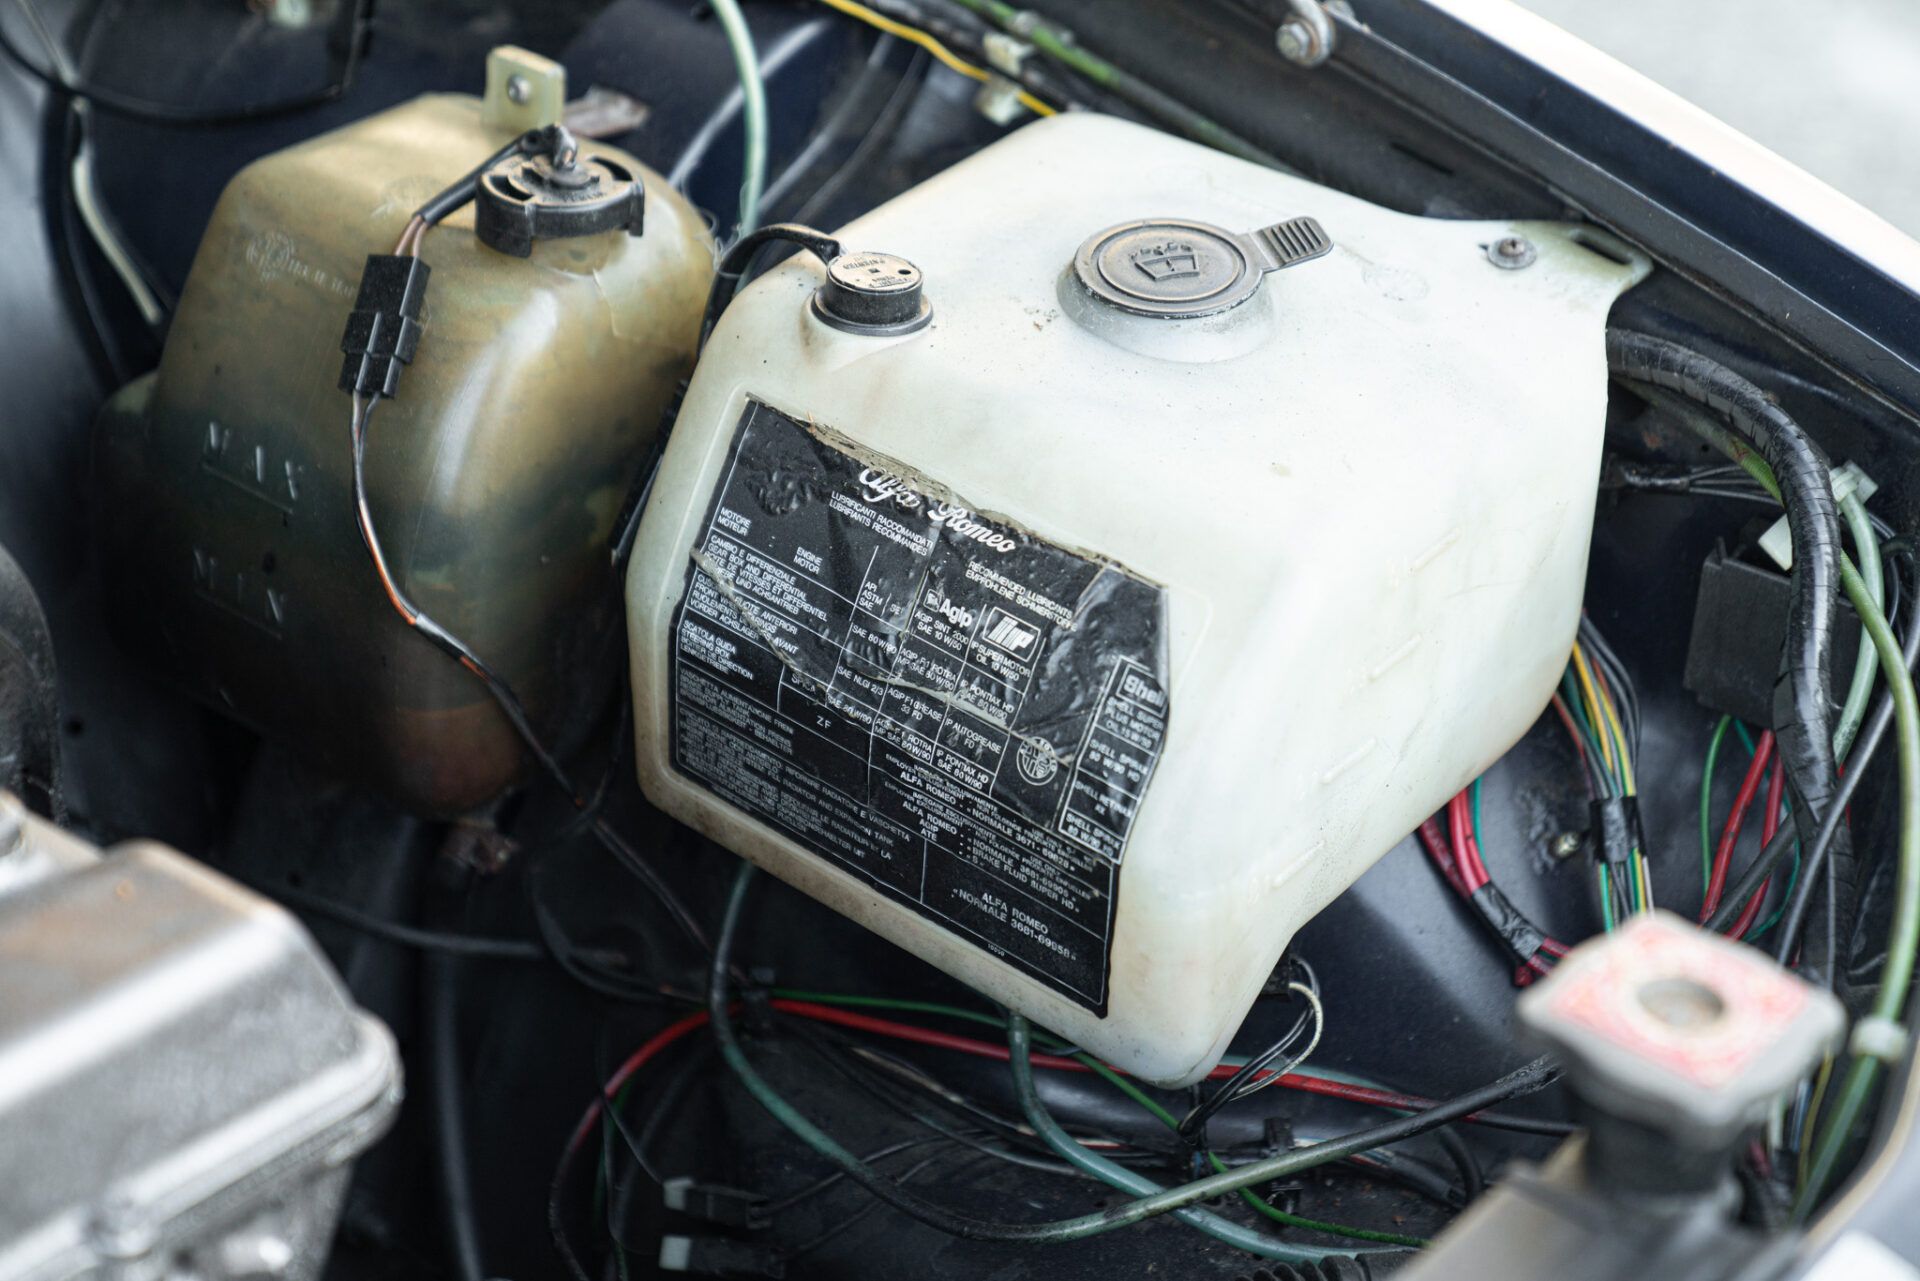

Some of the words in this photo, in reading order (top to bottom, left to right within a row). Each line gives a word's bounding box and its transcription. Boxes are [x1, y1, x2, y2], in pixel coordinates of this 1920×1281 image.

[720, 507, 750, 527] MOTORE
[831, 490, 876, 519] LUBRIFICANTI
[876, 514, 934, 549] RACCOMANDATI
[858, 467, 920, 511] Alfa
[927, 498, 1016, 552] Romeo
[717, 515, 747, 536] MOTEUR
[828, 499, 870, 526] LUBRIFIANTS
[871, 521, 927, 556] RECOMMANDES
[710, 534, 737, 554] CAMBIO
[738, 549, 745, 557] E
[745, 553, 796, 584] DIFFERENZIALE
[793, 554, 819, 574] MOTOR
[796, 546, 822, 565] ENGINE
[707, 542, 727, 558] GEAR
[728, 553, 744, 567] BOX
[744, 562, 760, 575] AND
[762, 571, 807, 601] DIFFERENTIAL
[864, 580, 877, 592] API
[965, 569, 1014, 600] EMPFOHLENE
[968, 560, 1026, 595] RECOMMENDED
[694, 581, 718, 599] FRONT
[726, 562, 737, 572] DE
[739, 568, 771, 590] VITESSES
[771, 585, 780, 595] ET
[782, 591, 828, 621] DIFFERENTIEL
[735, 576, 751, 589] UND
[752, 585, 799, 615] ACHSANTRIEB
[858, 597, 873, 610] SAE
[861, 589, 882, 605] ASTM
[689, 598, 717, 618] VORDER
[719, 613, 759, 640] ACHSLAGER
[761, 610, 797, 635] ANTERIORI
[914, 611, 932, 625] AGIP
[933, 621, 951, 634] SINT
[951, 630, 969, 644] 2000
[917, 621, 932, 634] SAE
[938, 598, 974, 630] Agip
[681, 627, 714, 651] STEERING
[714, 646, 730, 659] BOX
[683, 619, 714, 642] SCATOLA
[715, 637, 736, 654] GUIDA
[852, 625, 866, 638] SAE
[897, 656, 909, 666] MP
[910, 663, 925, 675] SAE
[901, 647, 917, 662] AGIP
[931, 663, 955, 681] ROTRA
[970, 641, 978, 650] IP
[977, 644, 1003, 663] SUPER
[1002, 657, 1030, 677] MOTOR
[975, 654, 988, 665] OIL
[837, 666, 851, 679] SAE
[853, 674, 869, 688] NLGI
[870, 684, 883, 696] 2/3
[1124, 673, 1165, 706] Shell
[826, 694, 841, 709] SAE
[888, 687, 904, 701] AGIP
[913, 701, 942, 722] GREASE
[960, 679, 968, 689] IP
[969, 684, 1001, 706] PONTIAX
[1001, 701, 1014, 714] HD
[1107, 695, 1134, 715] SHELL
[911, 709, 922, 721] FD
[1105, 706, 1128, 724] PLUS
[887, 732, 900, 744] SAE
[907, 733, 932, 752] ROTRA
[945, 718, 952, 727] IP
[952, 721, 1001, 754] AUTOGREASE
[964, 738, 974, 749] FD
[936, 749, 943, 758] IP
[945, 754, 975, 776] PONTIAX
[977, 772, 988, 784] HD
[937, 759, 951, 772] SAE
[900, 770, 923, 787] ALFA
[925, 783, 956, 805] ROMEO
[860, 809, 866, 819] E
[868, 812, 910, 842] VASCHETTA
[902, 800, 924, 818] ALFA
[926, 813, 957, 836] ROMEO
[1066, 812, 1091, 832] SHELL
[874, 831, 894, 848] TANK
[920, 826, 937, 842] ATE
[880, 848, 892, 861] LA
[919, 817, 938, 834] AGIP
[1003, 864, 1027, 884] FLUID
[1030, 879, 1058, 901] SUPER
[981, 890, 1008, 913] ALFA
[1011, 906, 1048, 935] ROMEO
